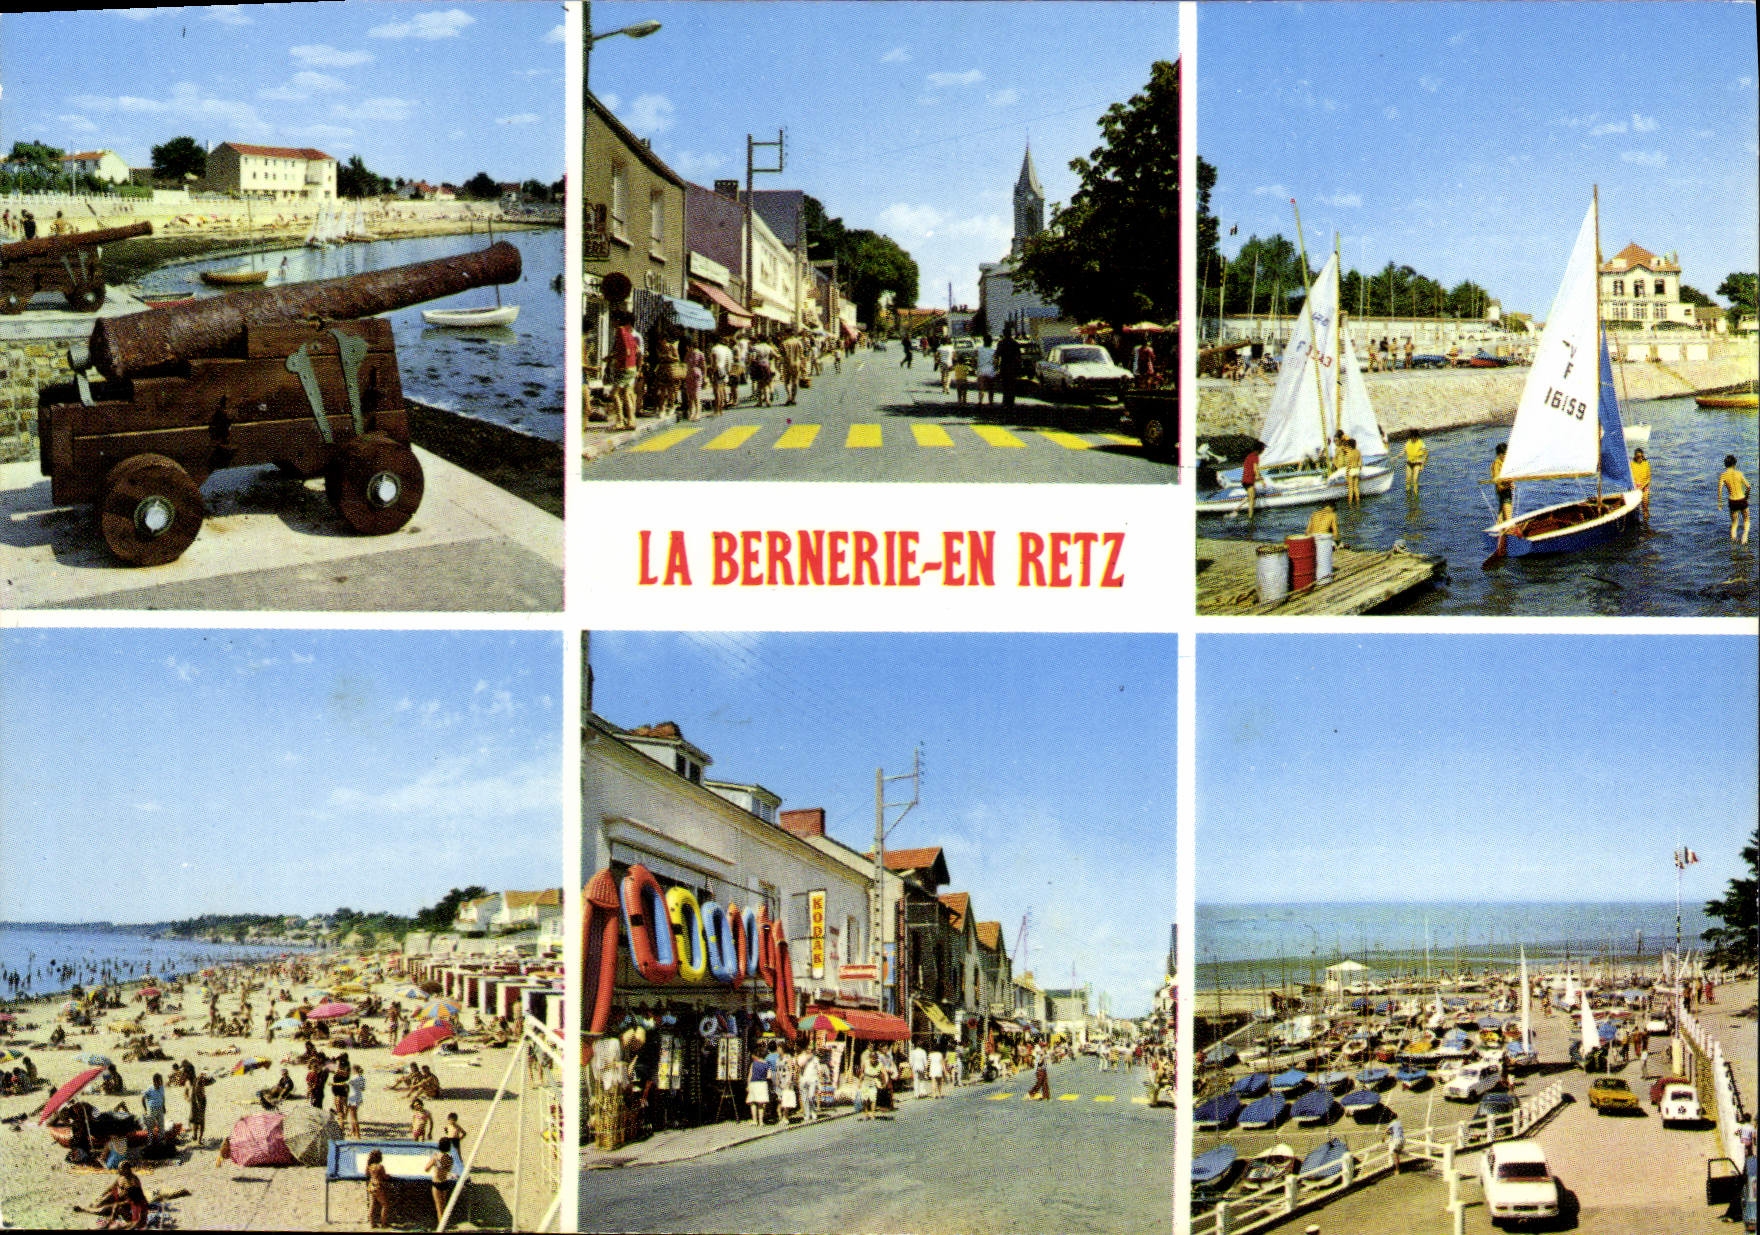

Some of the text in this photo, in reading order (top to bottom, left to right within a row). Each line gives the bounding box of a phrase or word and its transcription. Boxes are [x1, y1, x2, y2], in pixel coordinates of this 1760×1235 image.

[1564, 361, 1574, 380] F
[1544, 386, 1588, 421] 16159
[812, 897, 824, 964] KODAK
